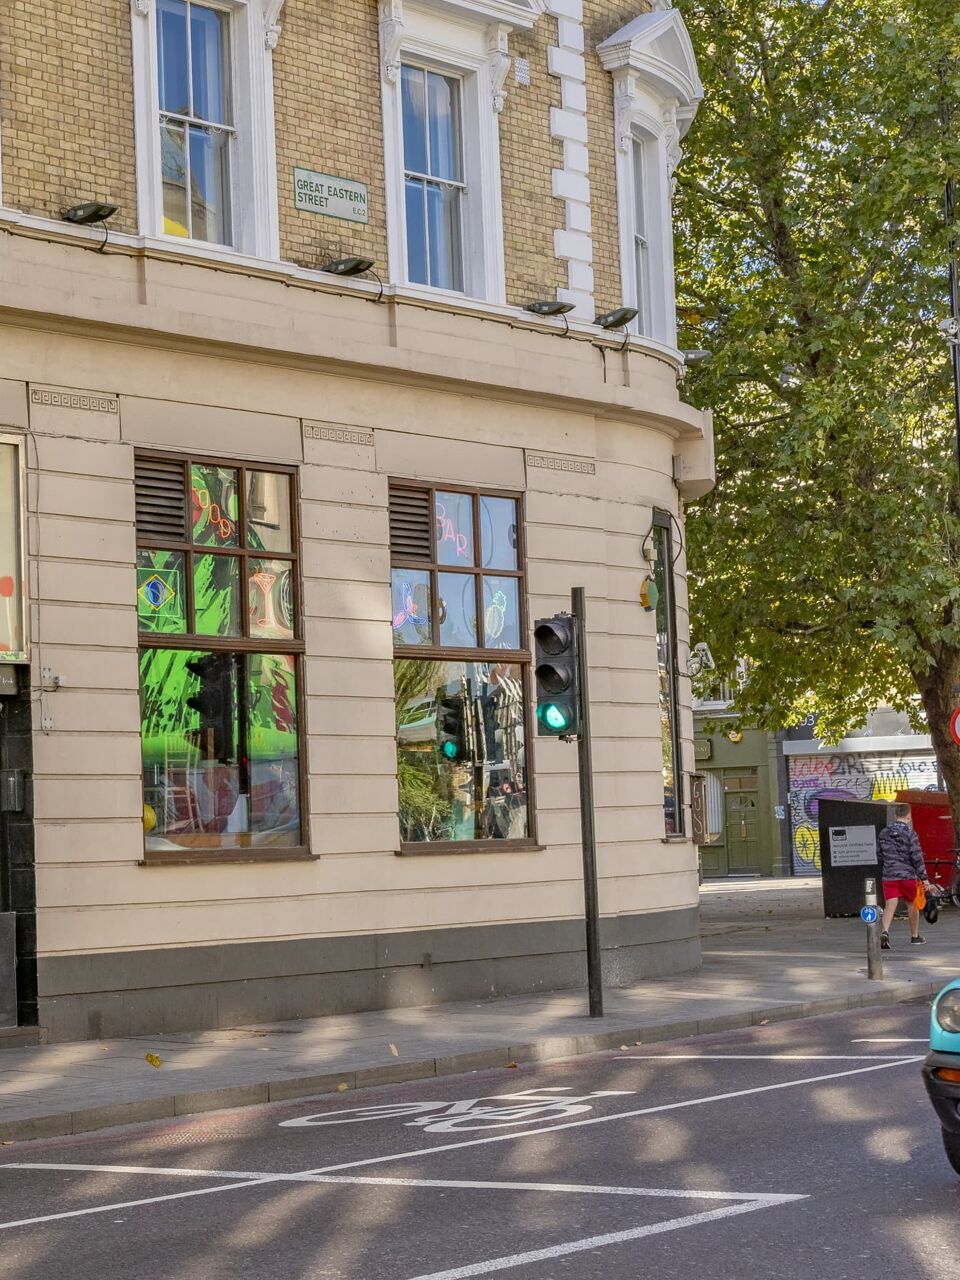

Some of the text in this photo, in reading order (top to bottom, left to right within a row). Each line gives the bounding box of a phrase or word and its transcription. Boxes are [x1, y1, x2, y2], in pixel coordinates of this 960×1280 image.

[296, 179, 366, 204] GREAT EASTERN
[297, 191, 329, 208] STREET
[192, 488, 231, 538] OOD
[435, 502, 469, 558] BAR
[693, 781, 703, 834] GUS
